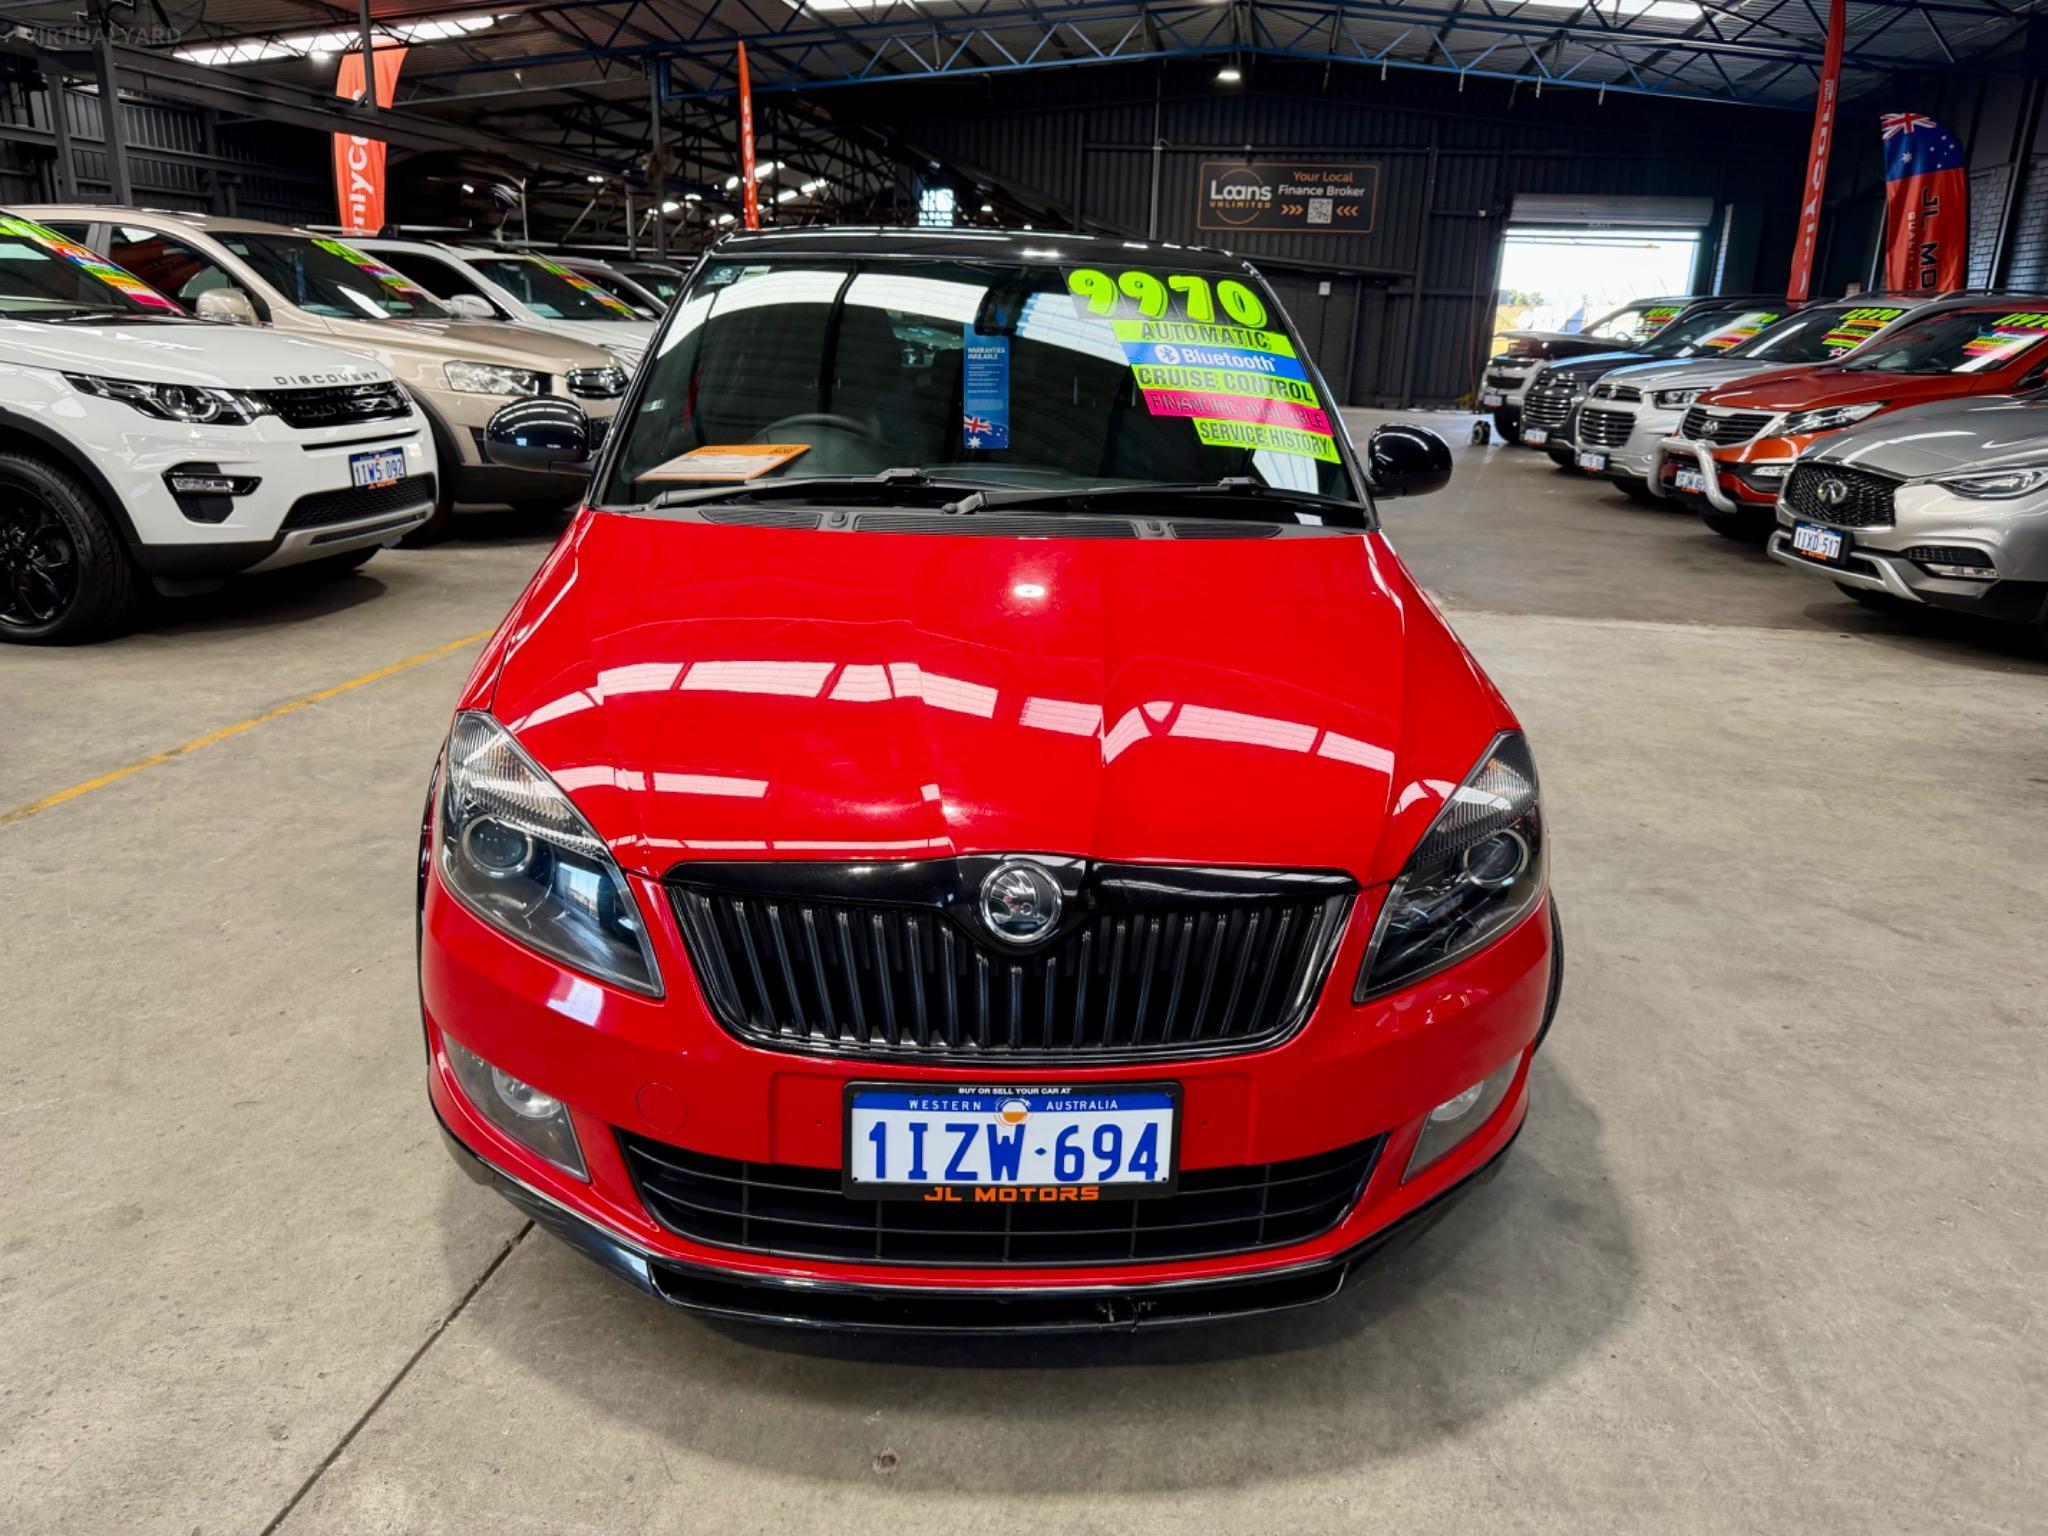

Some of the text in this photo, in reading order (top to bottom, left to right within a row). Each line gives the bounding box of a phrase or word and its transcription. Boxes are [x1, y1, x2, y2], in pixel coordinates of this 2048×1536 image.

[1293, 171, 1354, 183] Your Local
[1210, 179, 1273, 200] Loans
[1278, 184, 1366, 197] Finance Broker
[1209, 201, 1272, 209] UNLIMITED
[1068, 268, 1268, 328] 9970
[1141, 323, 1272, 350] AUTOMATIC
[1182, 348, 1275, 372] Bluetooth
[273, 371, 380, 386] DISCOVERY
[1139, 368, 1313, 402] CRUISE CONTROL
[1150, 394, 1324, 430] FINANCING AVAILABLE
[1200, 422, 1329, 455] SERVICE HISTORY
[992, 1087, 1014, 1095] SELL
[1016, 1087, 1039, 1095] YOUR
[1041, 1087, 1059, 1095] CAR
[1060, 1087, 1072, 1095] AT
[909, 1099, 1118, 1111] WESTERN AUSTRALIA
[924, 1186, 1101, 1202] JL MOTORS
